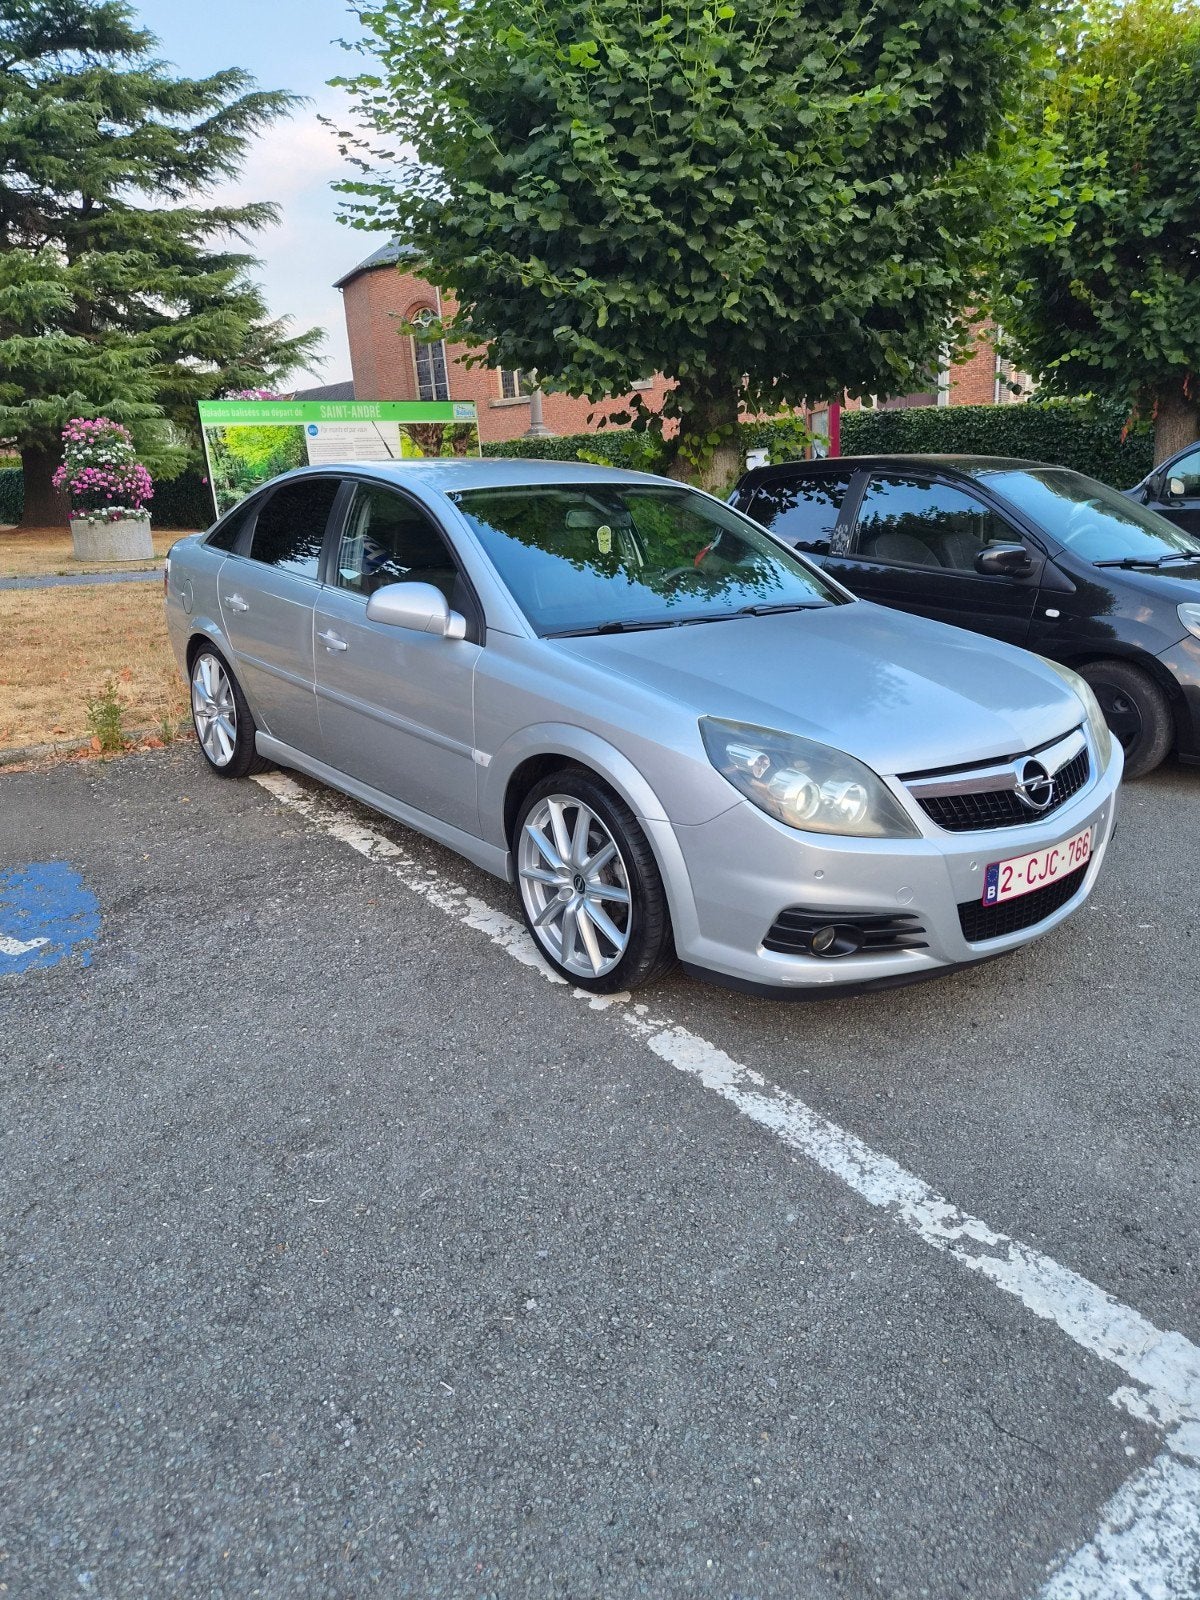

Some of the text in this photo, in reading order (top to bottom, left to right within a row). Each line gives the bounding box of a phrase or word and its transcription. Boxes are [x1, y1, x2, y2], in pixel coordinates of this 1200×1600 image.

[202, 408, 230, 417] Balades
[271, 407, 293, 418] départ
[295, 408, 303, 417] de
[320, 402, 382, 419] SAINT-ANDRÉ
[987, 885, 996, 899] B
